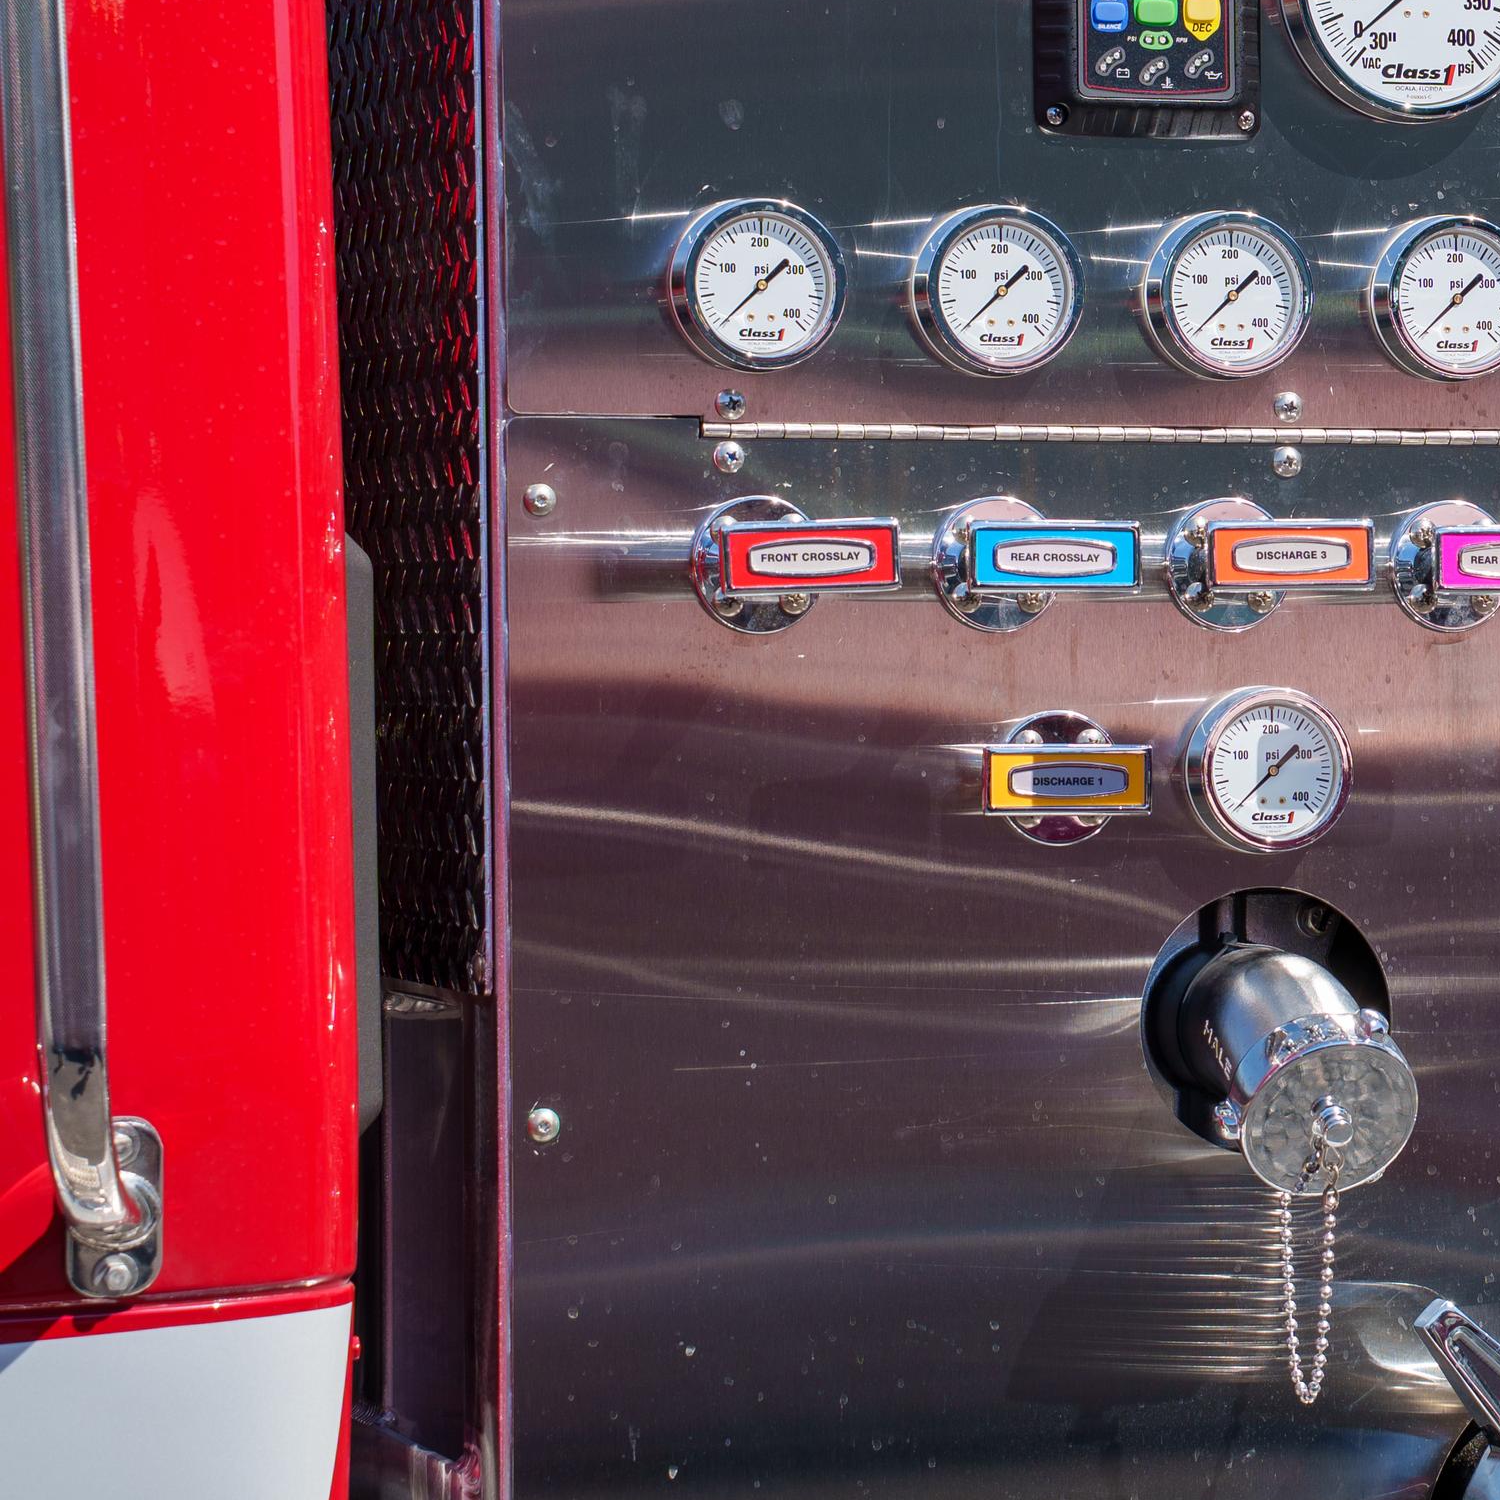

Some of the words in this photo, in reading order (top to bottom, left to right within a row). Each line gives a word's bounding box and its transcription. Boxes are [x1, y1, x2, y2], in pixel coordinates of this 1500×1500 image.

[1193, 23, 1212, 32] DEC
[1354, 21, 1363, 38] 0
[1447, 29, 1475, 46] 400
[1362, 58, 1381, 70] VAC
[1458, 61, 1474, 76] psi
[1382, 64, 1456, 86] Class1
[751, 237, 769, 247] 200
[991, 244, 1009, 254] 200
[1222, 250, 1239, 259] 200
[1447, 253, 1463, 263] 200
[720, 263, 736, 273] 100
[754, 264, 769, 276] psi
[960, 270, 977, 279] 100
[1192, 275, 1208, 284] 100
[1418, 278, 1433, 288] 100
[783, 309, 801, 319] 400
[1022, 314, 1039, 324] 400
[1252, 318, 1268, 328] 400
[1476, 321, 1492, 331] 400
[739, 328, 785, 341] Class1
[980, 334, 1024, 346] Class1
[1211, 338, 1254, 350] Class1
[1437, 340, 1478, 352] Class1
[761, 553, 798, 562] FRONT
[802, 552, 860, 561] CROSSLAY
[1011, 553, 1039, 561] REAR
[1044, 553, 1100, 562] CROSSLAY
[1257, 551, 1317, 560] DISCHARGE
[1321, 551, 1327, 559] 3
[1471, 556, 1498, 564] REAR
[1263, 725, 1279, 734] 200
[1233, 751, 1248, 760] 100
[1266, 750, 1279, 762] psi
[1033, 777, 1094, 786] DISCHARGE
[1292, 792, 1309, 801] 400
[1252, 811, 1295, 824] Class1
